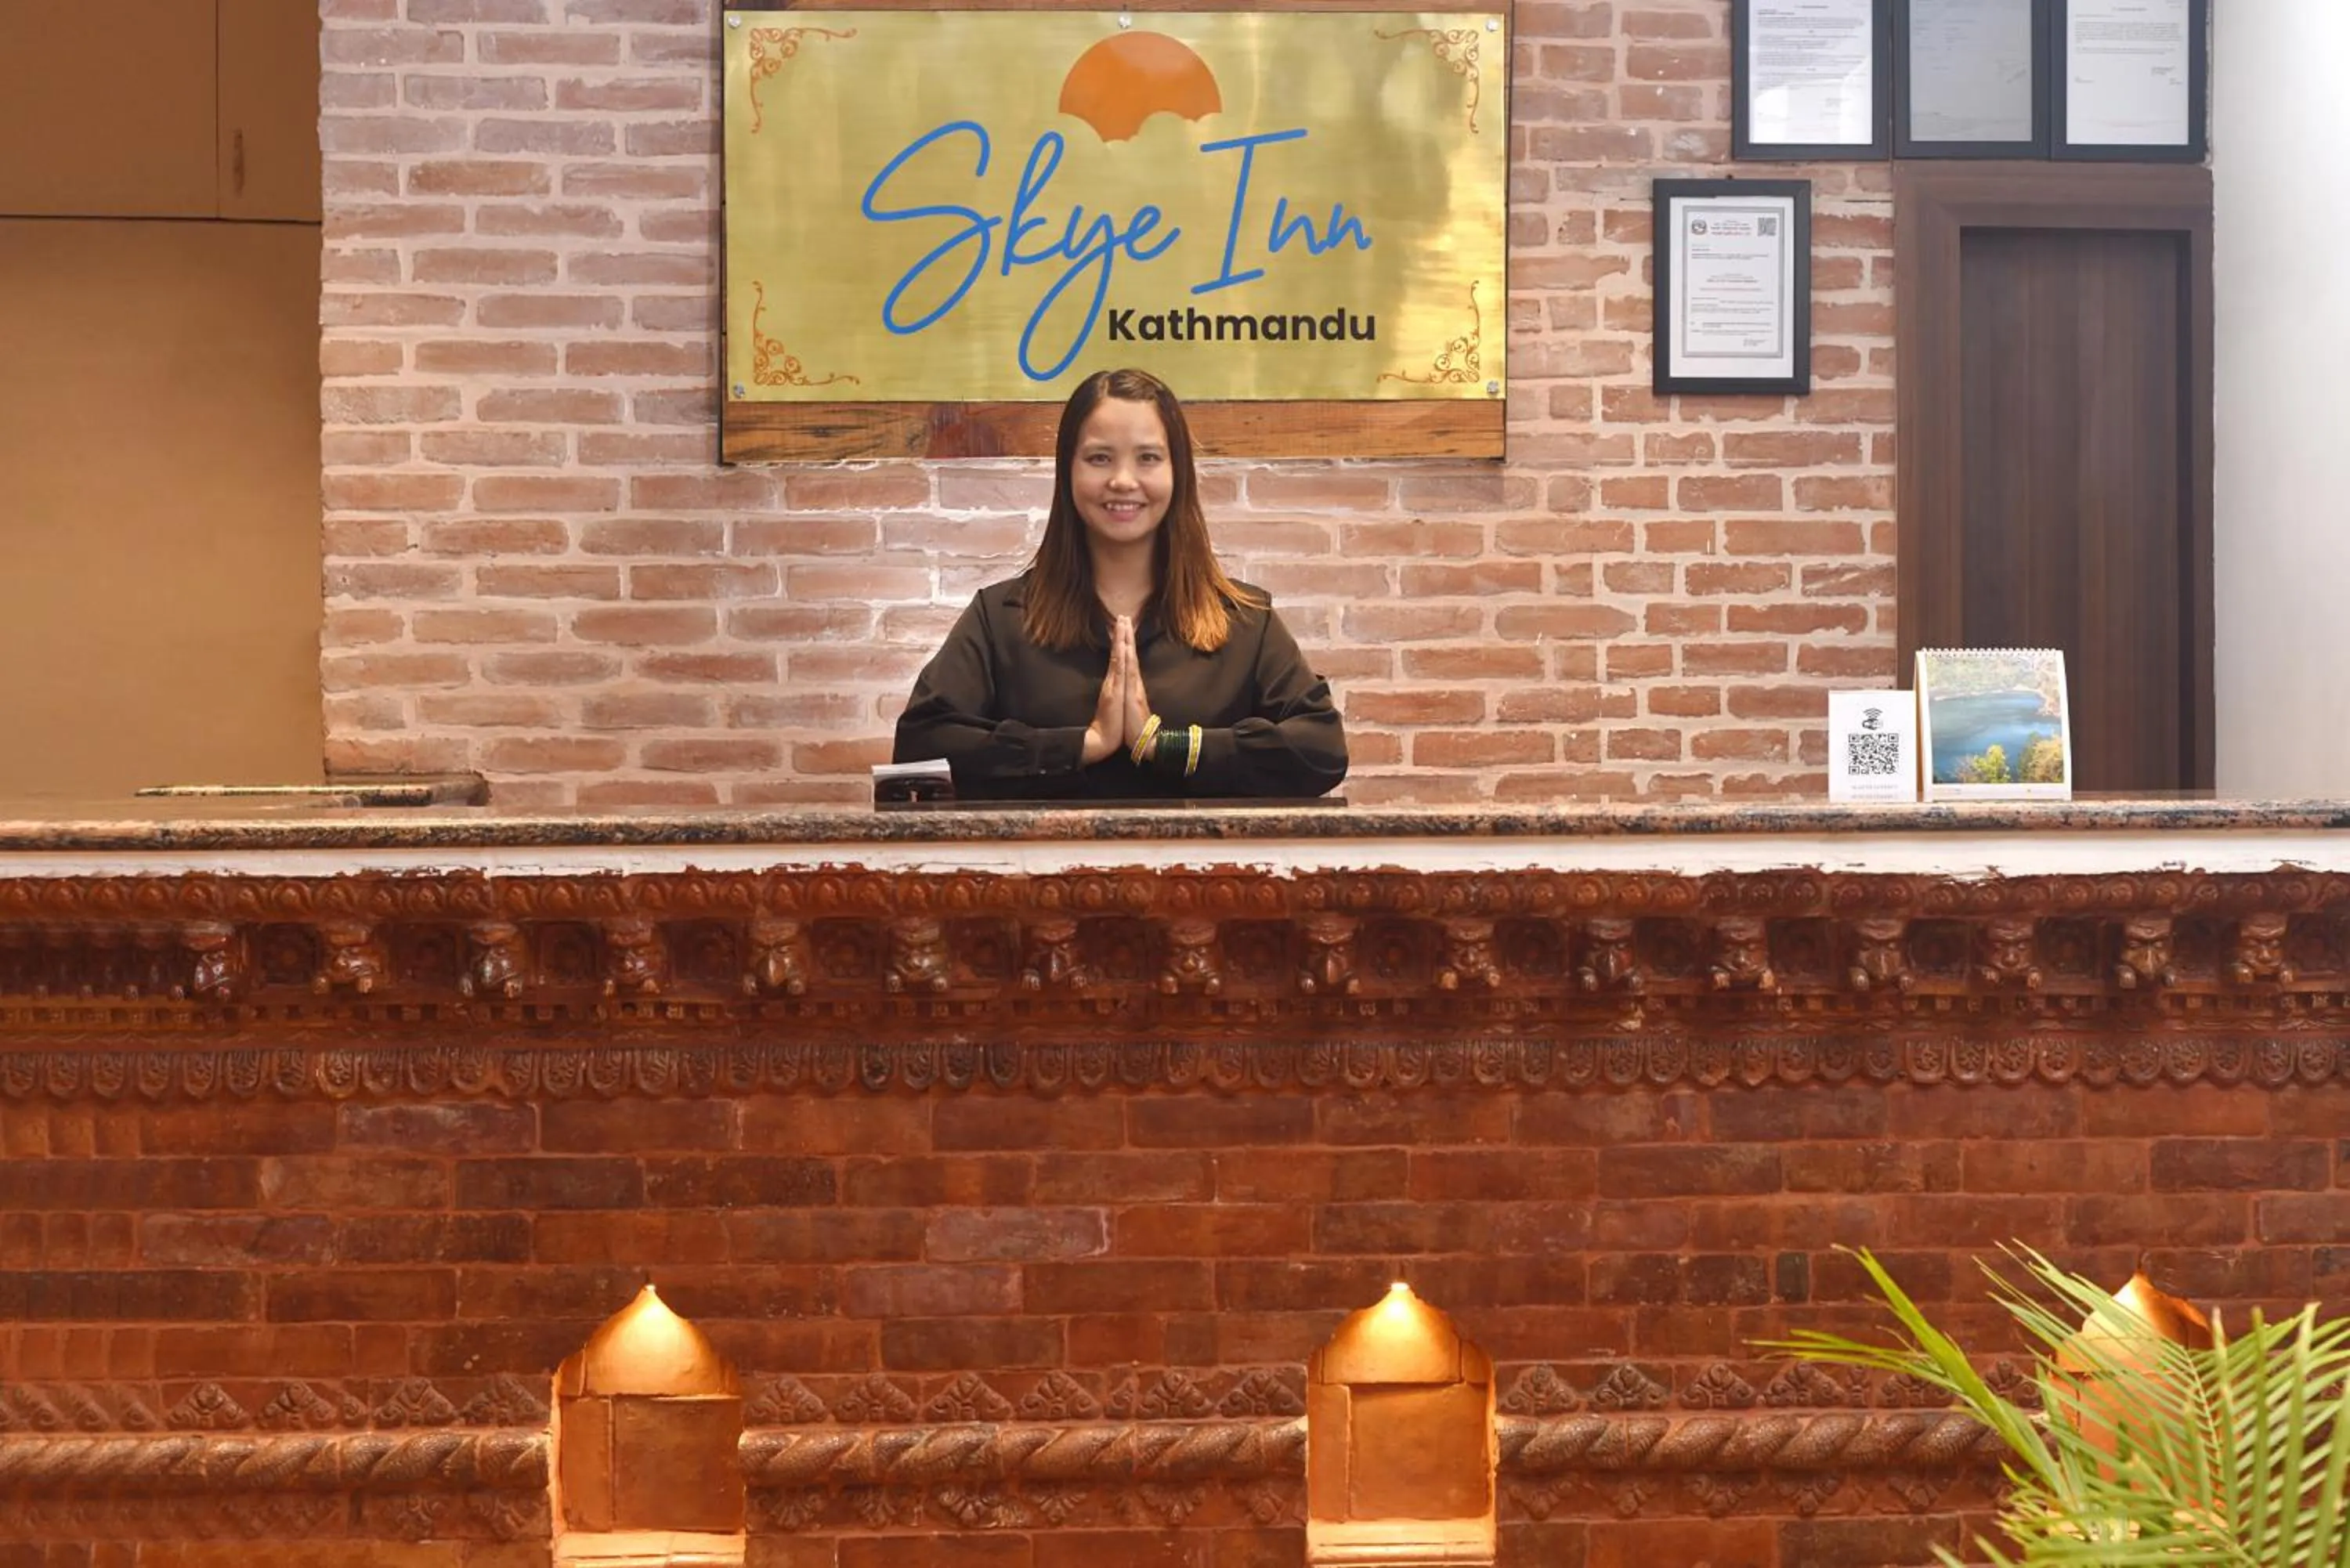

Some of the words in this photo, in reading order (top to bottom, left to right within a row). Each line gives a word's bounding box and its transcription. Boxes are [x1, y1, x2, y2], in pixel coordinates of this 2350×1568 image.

[862, 121, 1180, 381] Skye
[1191, 128, 1372, 294] Inn
[1108, 307, 1376, 341] Kathmandu
